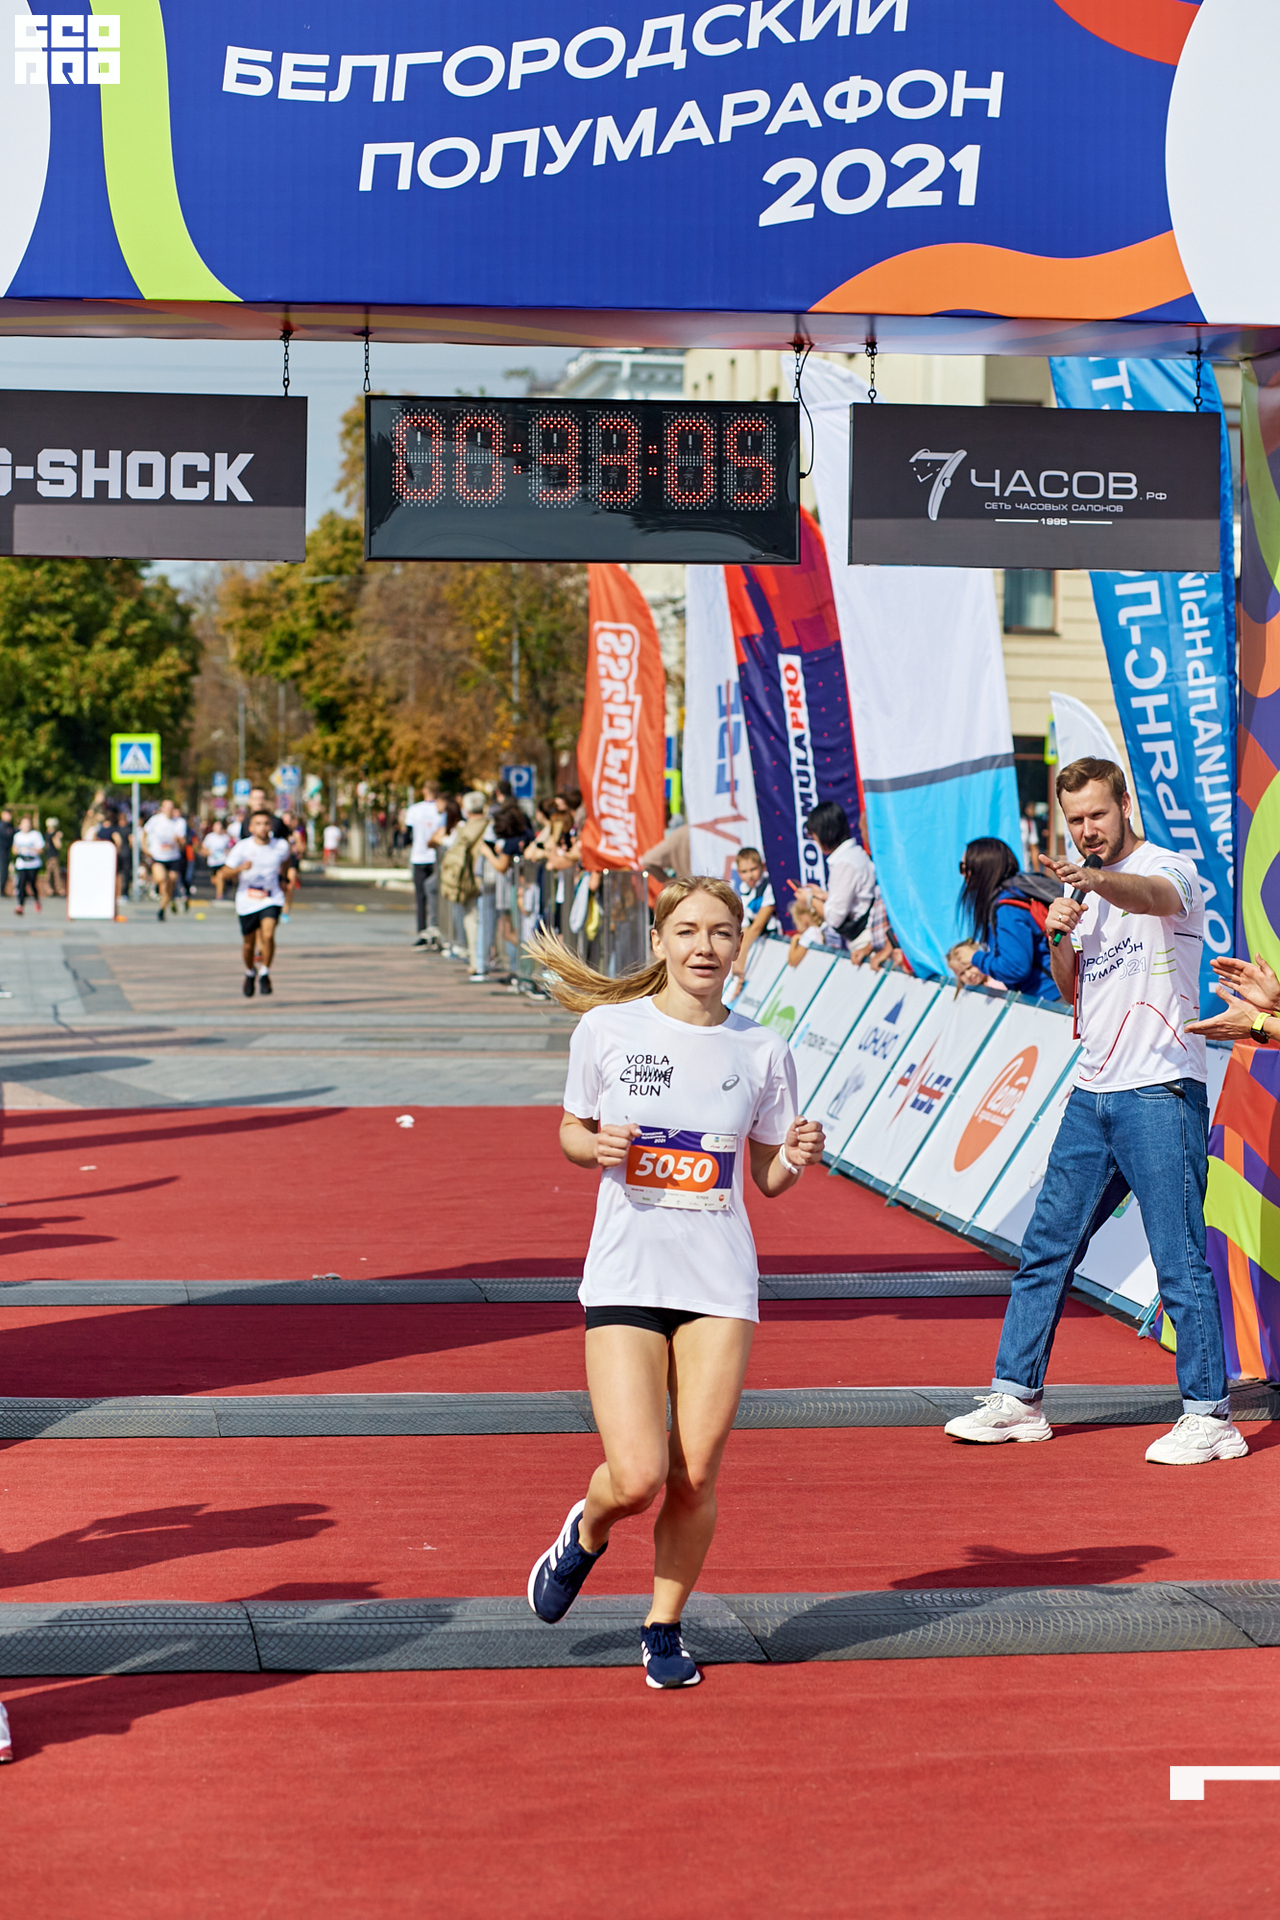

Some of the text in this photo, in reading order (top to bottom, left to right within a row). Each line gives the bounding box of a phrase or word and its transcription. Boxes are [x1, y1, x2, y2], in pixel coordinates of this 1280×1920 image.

[359, 70, 1004, 191] ПОЛУМАРАФОН
[759, 144, 981, 227] 2021
[393, 414, 775, 504] 00:33:05
[984, 501, 1124, 513] СЕТЬ ЧАСОВЫХ САЛОНОВ
[1041, 517, 1068, 526] 1995
[626, 1054, 670, 1065] VOBLA
[629, 1084, 661, 1097] RUN
[634, 1151, 713, 1183] 5050
